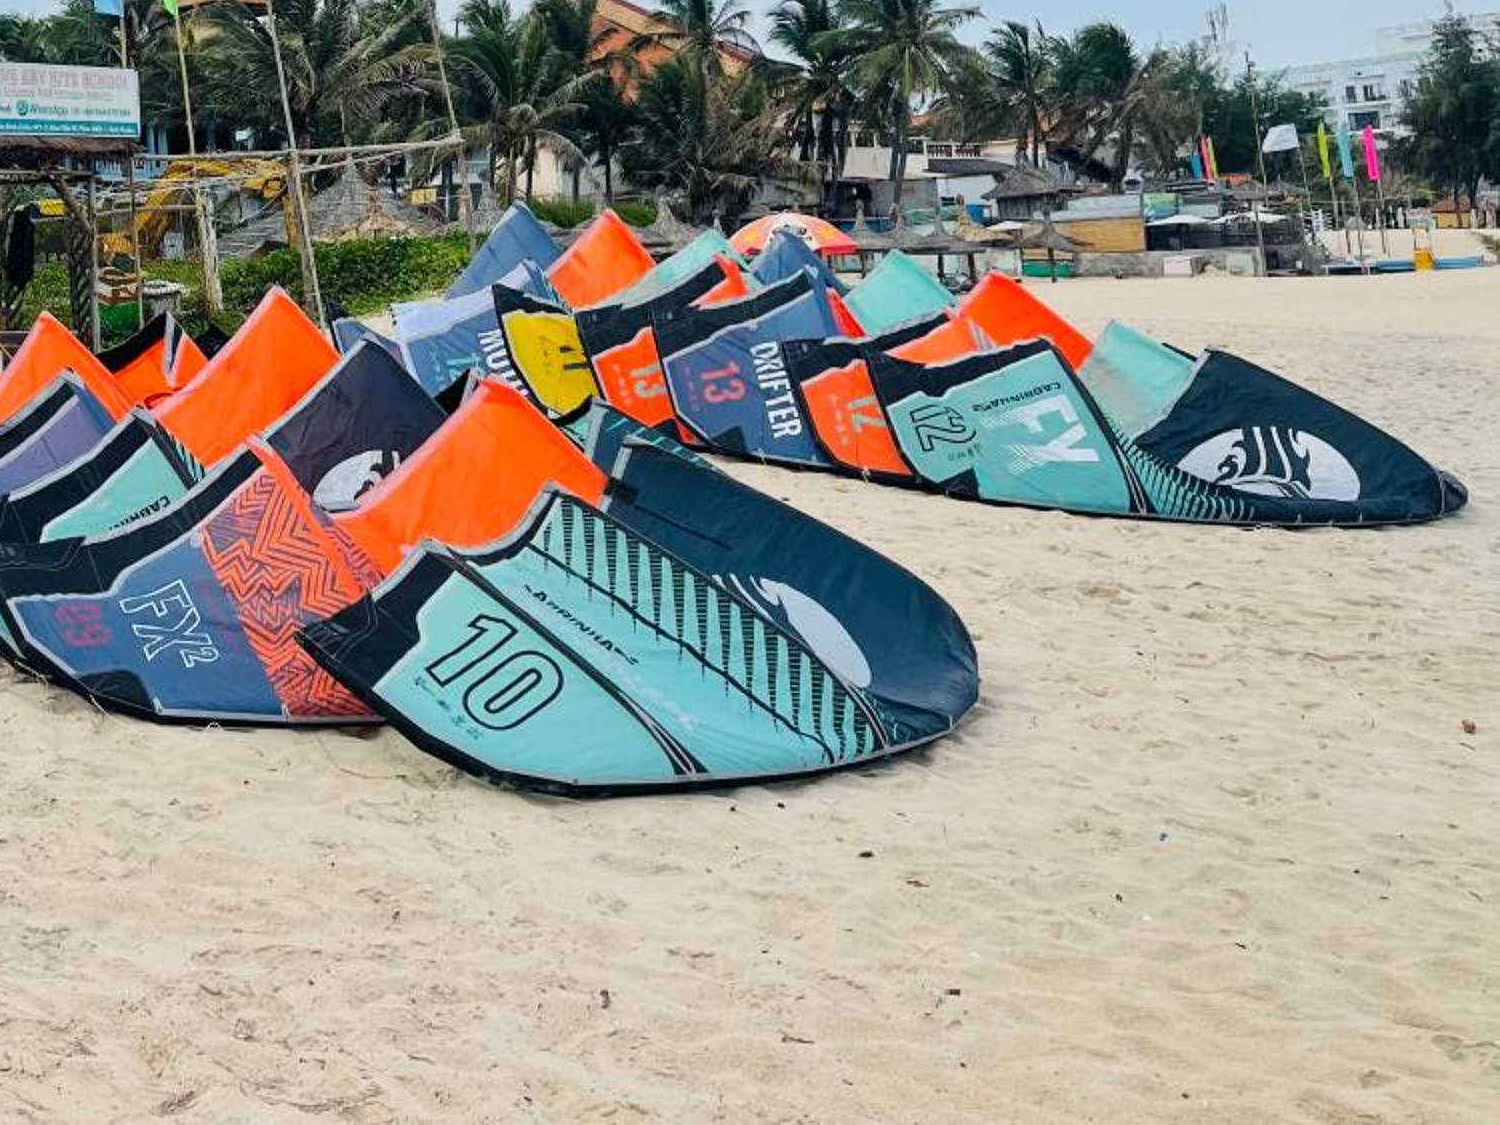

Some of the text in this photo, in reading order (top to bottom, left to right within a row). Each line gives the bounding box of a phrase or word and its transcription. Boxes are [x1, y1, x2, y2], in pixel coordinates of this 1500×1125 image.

[701, 360, 747, 404] 13
[750, 340, 804, 439] DRIFTER
[908, 403, 978, 453] 12
[979, 394, 1101, 476] FX
[424, 613, 565, 731] 10
